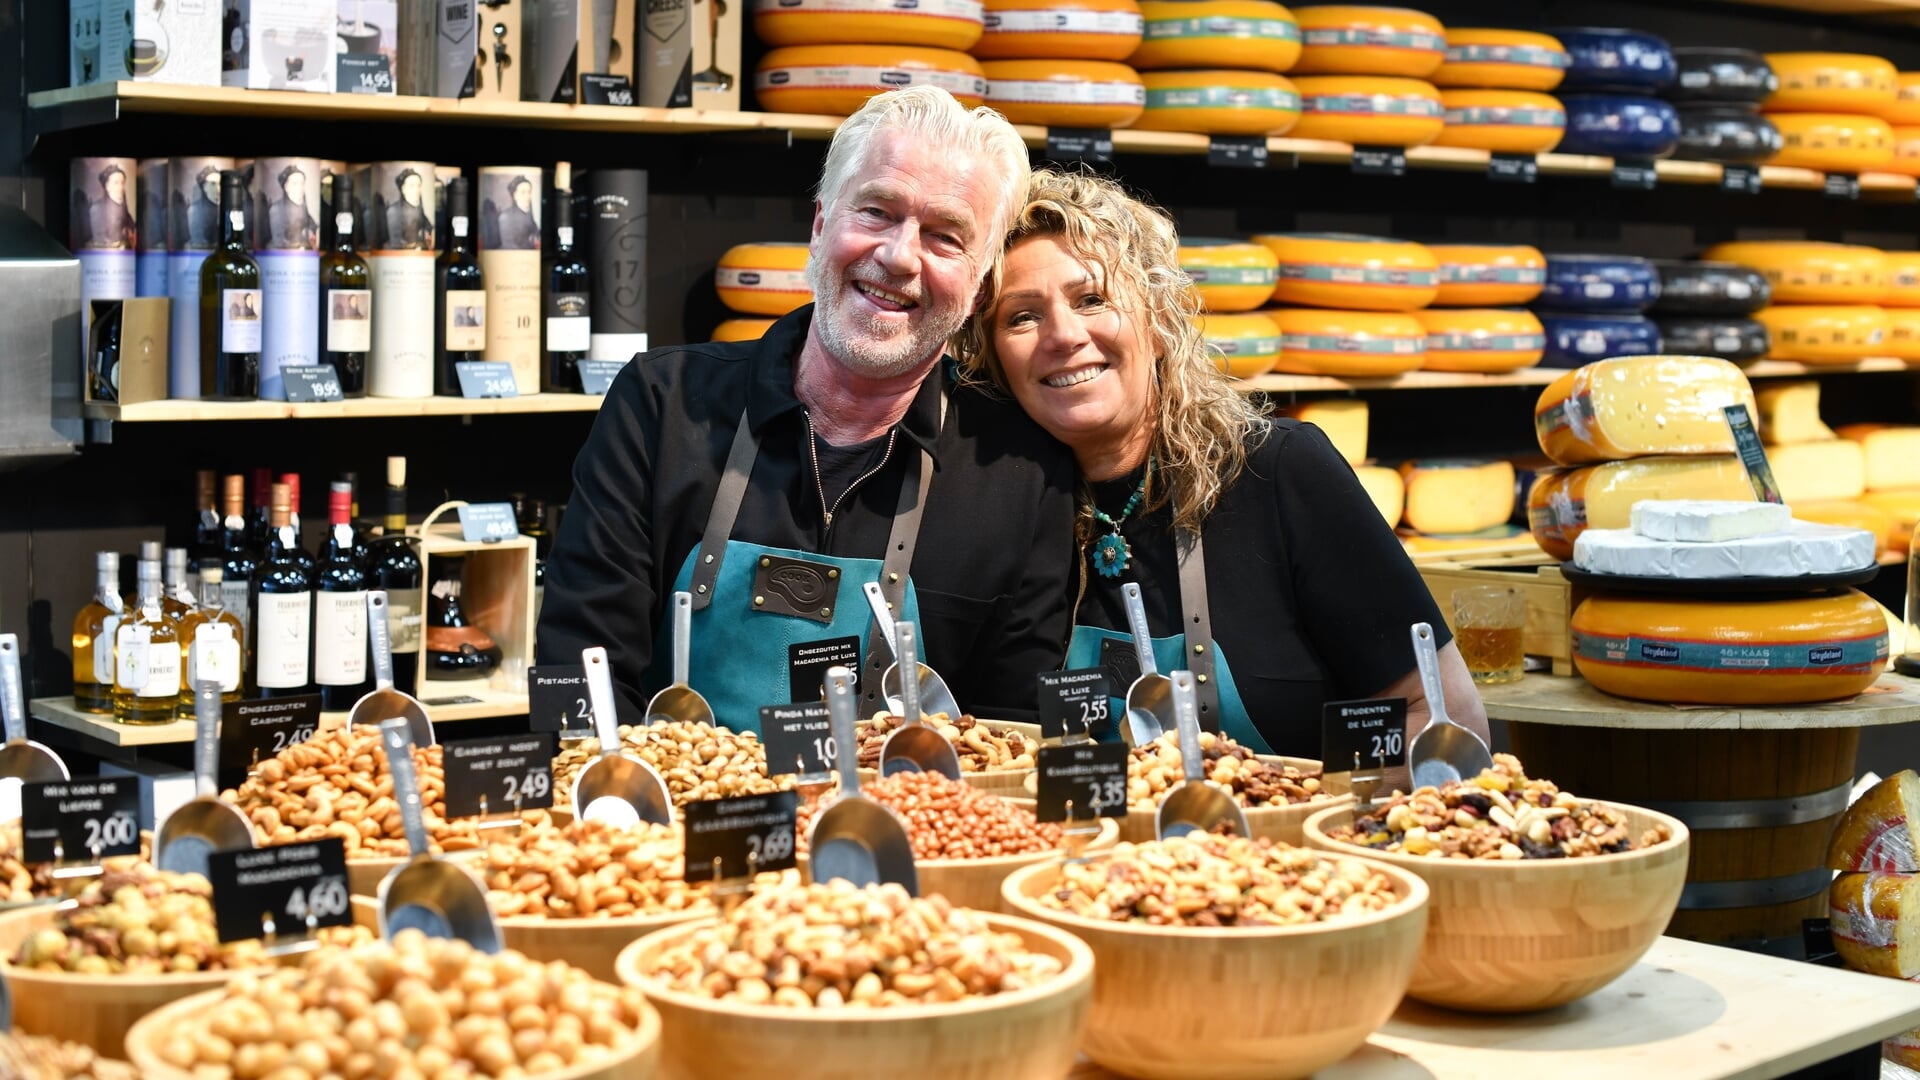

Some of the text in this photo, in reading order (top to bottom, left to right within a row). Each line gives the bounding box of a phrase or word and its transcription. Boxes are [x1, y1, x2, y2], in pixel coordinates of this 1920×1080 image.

[446, 3, 468, 21] WINE
[360, 72, 390, 89] 14,95
[517, 315, 531, 329] 10
[311, 382, 339, 398] 19,95
[799, 645, 839, 656] ONGEZOUTEN
[1643, 646, 1678, 659] Weydeland
[1741, 648, 1770, 657] KAAS
[1810, 650, 1842, 662] Weydeland
[794, 656, 829, 666] MACADEMIA
[841, 652, 856, 660] LUXE
[537, 677, 580, 685] PISTACHE
[1045, 673, 1103, 686] MIX MACADEMIA
[1059, 686, 1090, 697] DE LUXE
[238, 702, 307, 715] ONGEZOUTEN
[774, 708, 831, 719] PINDA NATA
[1080, 699, 1108, 723] 2,55
[1341, 705, 1391, 717] STUDENTEN
[250, 715, 293, 726] CASHEW
[783, 721, 830, 732] MET VLIES
[1347, 719, 1384, 729] DE LUXE
[272, 728, 314, 752] 249
[1371, 733, 1402, 757] 210
[454, 741, 541, 758] CASHEW NOOT
[496, 757, 527, 768] ZOUT
[83, 816, 138, 850] 2,00
[285, 879, 348, 920] 460
